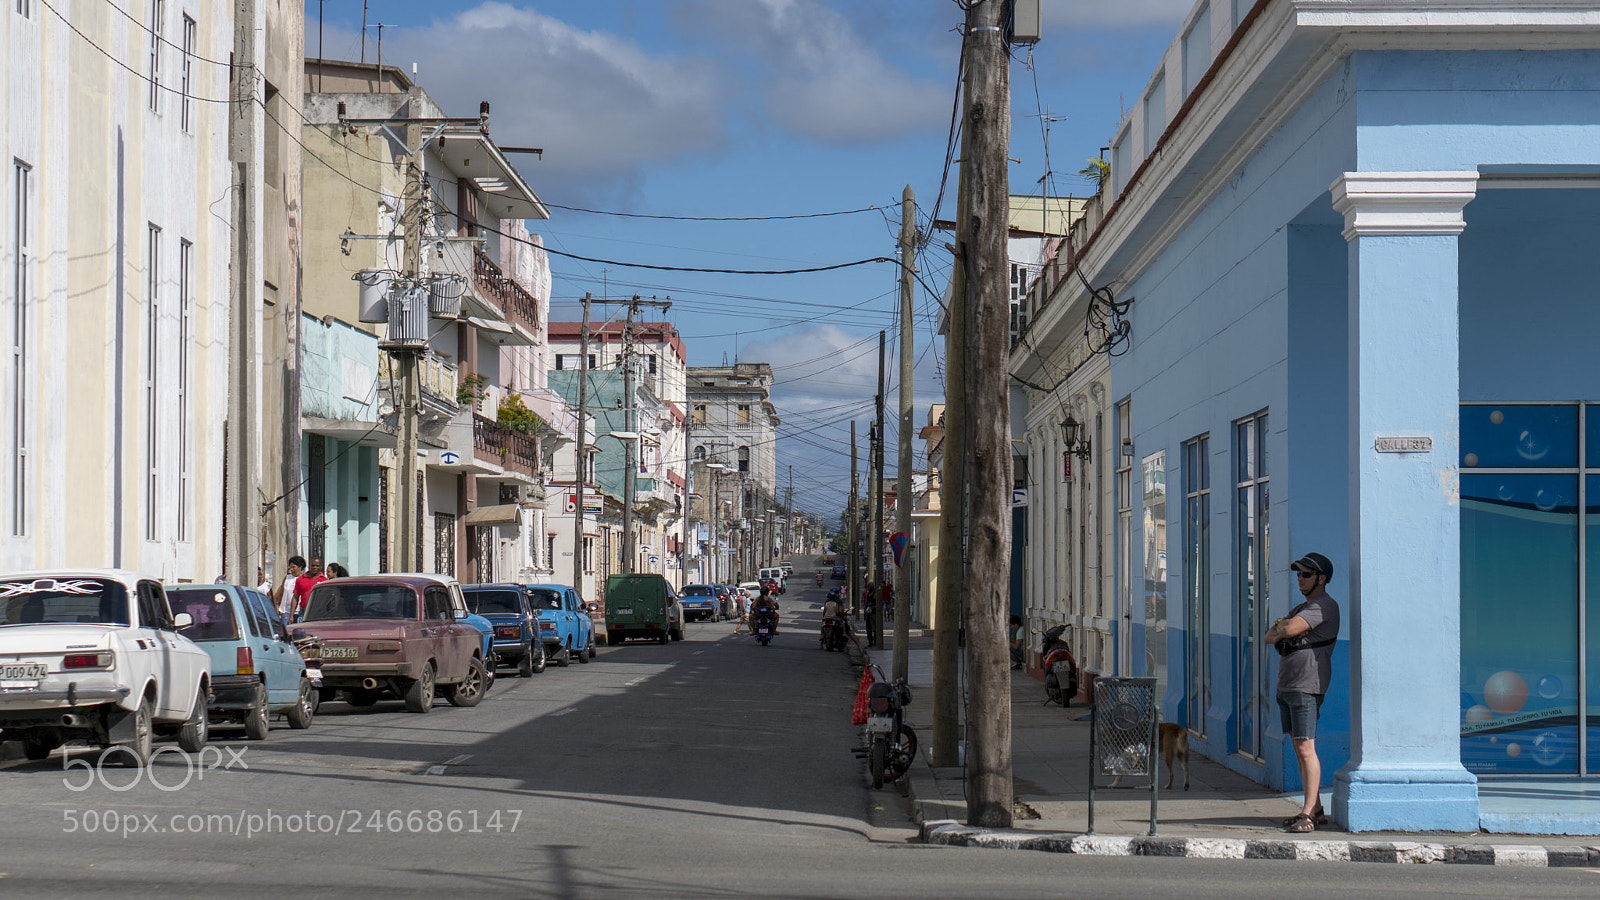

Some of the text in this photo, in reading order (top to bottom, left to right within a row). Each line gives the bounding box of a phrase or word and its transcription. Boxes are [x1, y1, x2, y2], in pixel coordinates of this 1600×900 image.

[1380, 438, 1413, 450] CALLE
[6, 666, 25, 679] 009
[27, 665, 47, 678] 474
